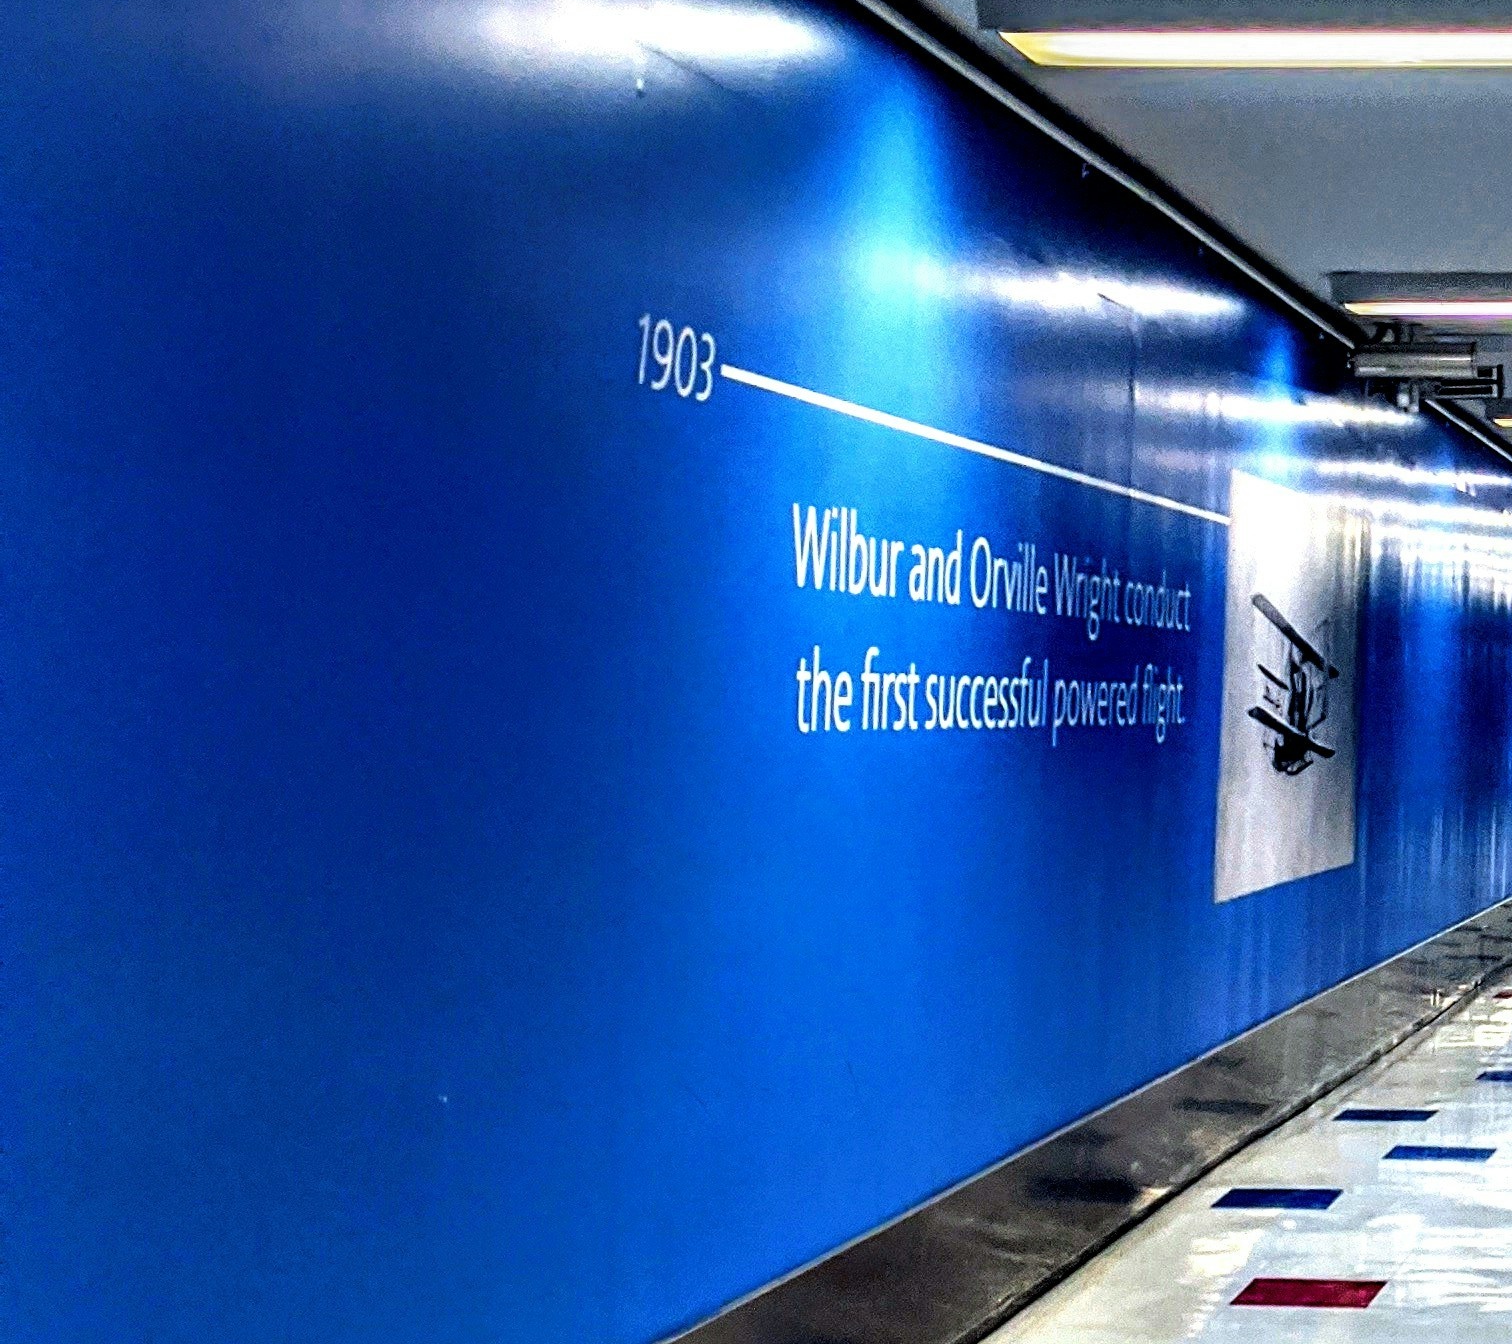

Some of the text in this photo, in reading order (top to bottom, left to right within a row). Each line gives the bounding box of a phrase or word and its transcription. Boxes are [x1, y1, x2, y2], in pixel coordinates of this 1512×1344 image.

[638, 312, 716, 401] 1903
[793, 503, 1191, 641] Wilbur and Orville Wright conduct
[797, 645, 852, 733] the
[861, 646, 920, 731] first
[925, 656, 1049, 730] successful
[1052, 664, 1139, 747] powered
